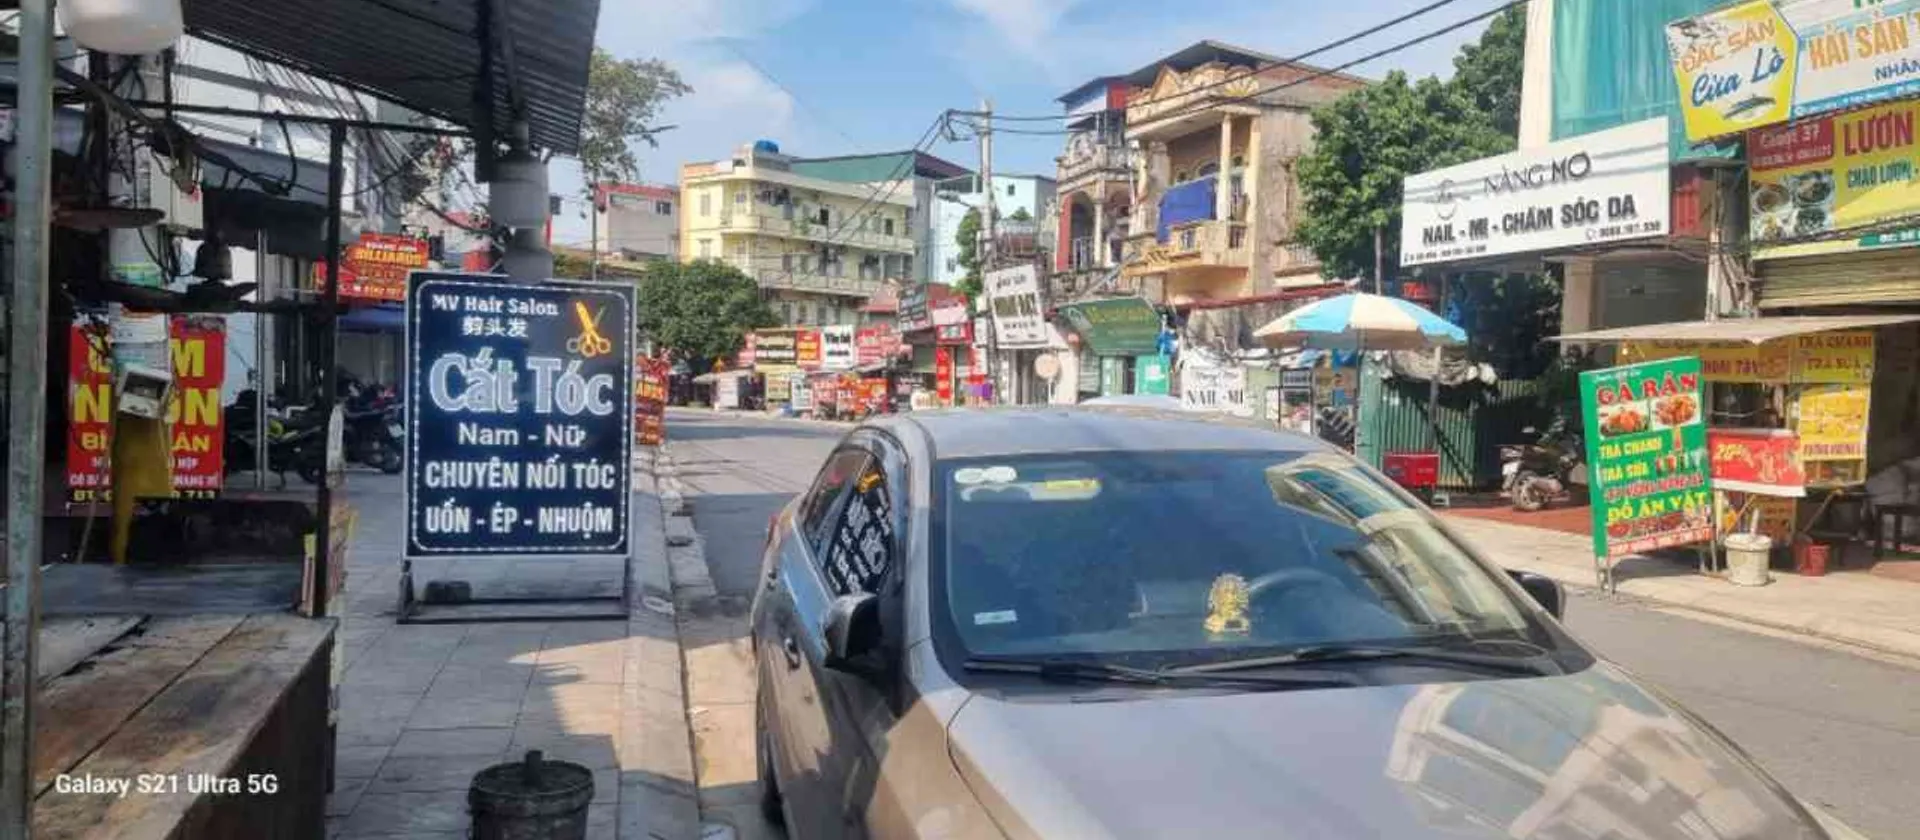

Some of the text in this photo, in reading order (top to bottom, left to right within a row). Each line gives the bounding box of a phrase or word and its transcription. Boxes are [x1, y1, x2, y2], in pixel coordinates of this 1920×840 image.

[1484, 164, 1546, 193] NÀNG
[1423, 223, 1457, 246] NAIL
[1560, 196, 1599, 227] SÓC
[1607, 194, 1637, 218] DA
[432, 294, 559, 316] MV Hair Salon
[462, 317, 528, 337] 剪头发
[430, 346, 614, 416] Cắt Tóc
[458, 422, 519, 446] Nam
[545, 424, 586, 447] Nữ
[425, 453, 615, 489] CHUYÊN NỐI TÓC
[425, 497, 470, 533] UỐN
[491, 501, 518, 533] ÉP
[538, 501, 613, 540] NHUỘM
